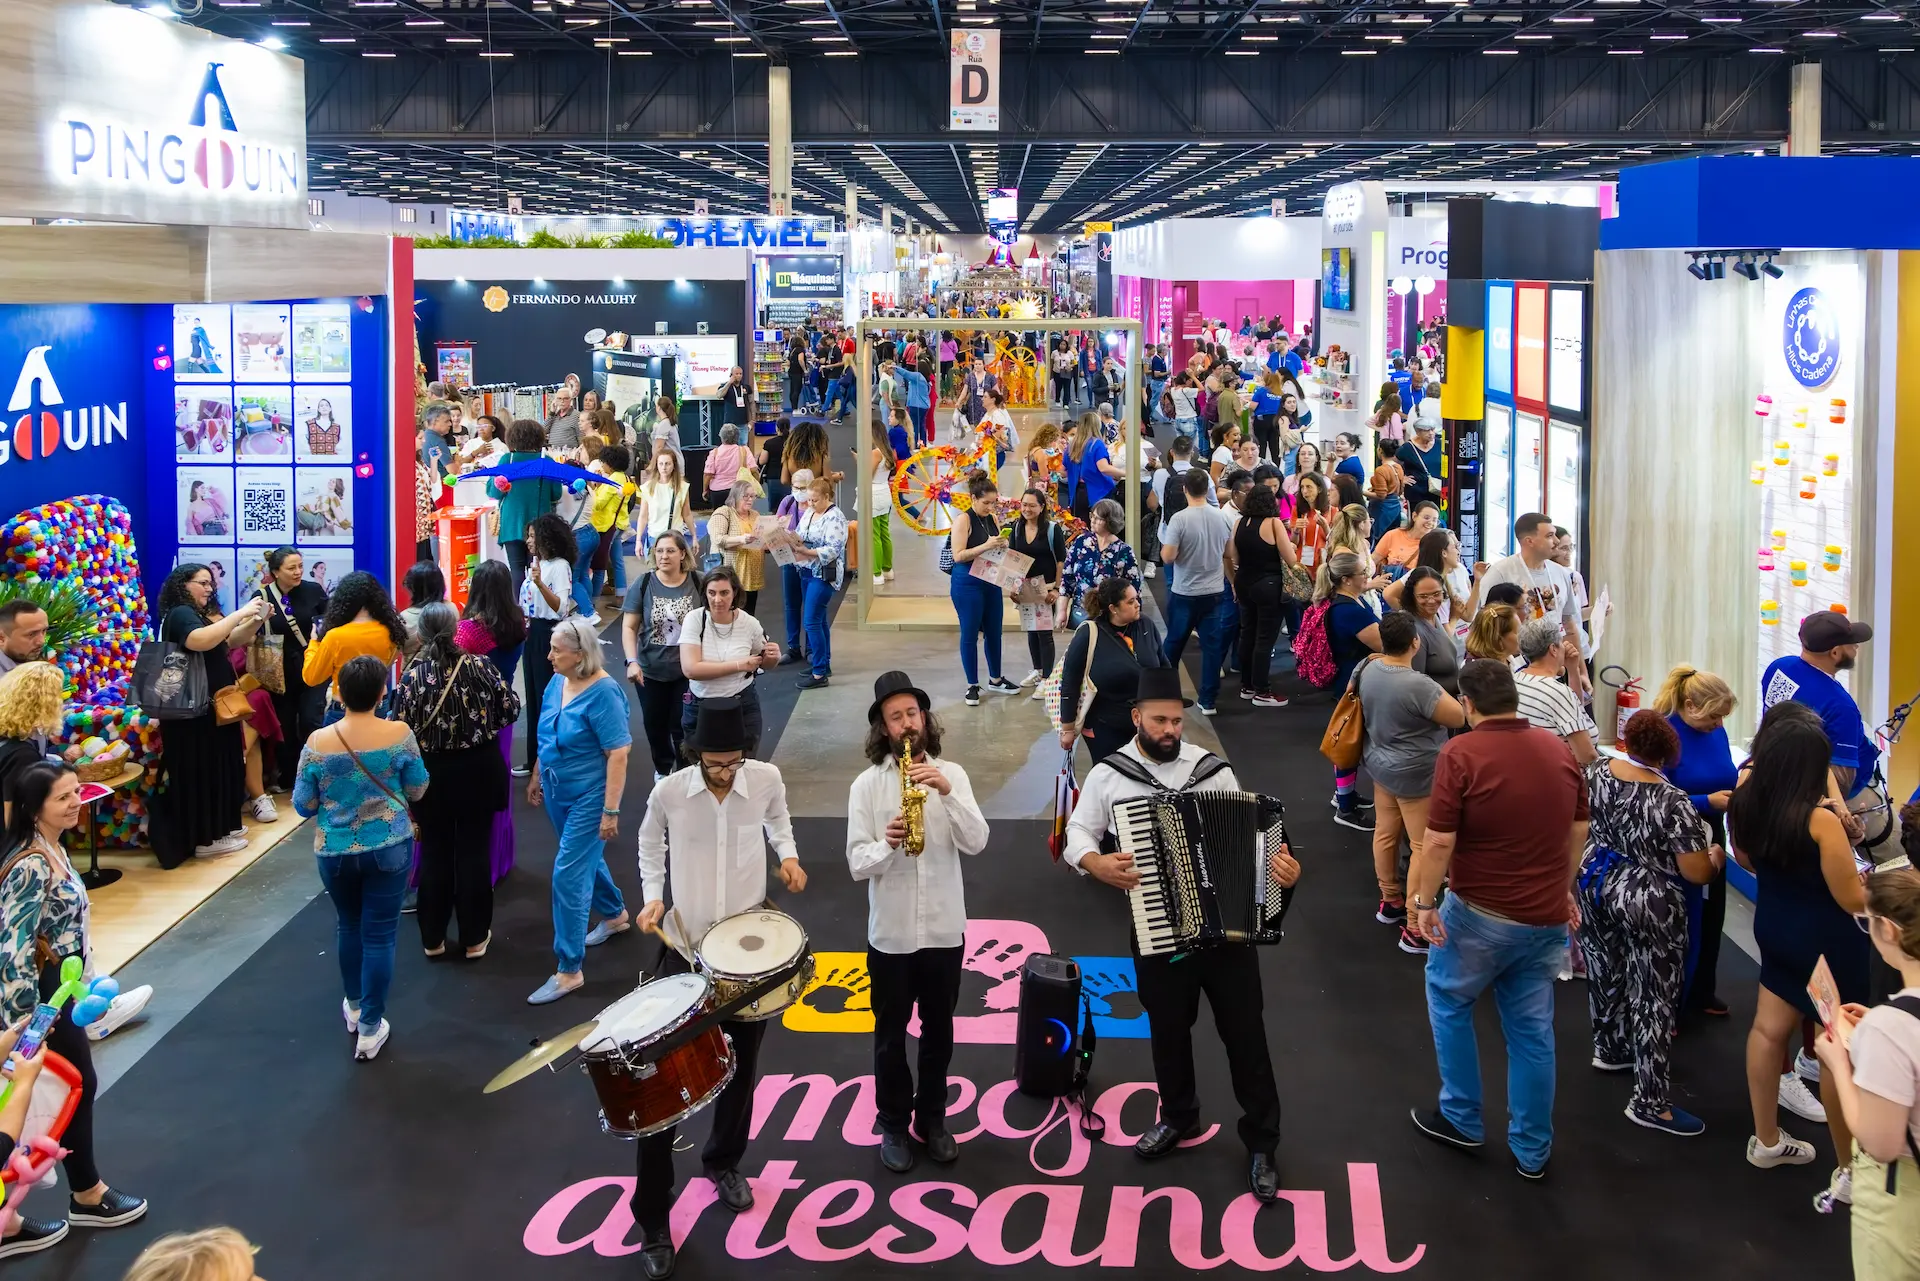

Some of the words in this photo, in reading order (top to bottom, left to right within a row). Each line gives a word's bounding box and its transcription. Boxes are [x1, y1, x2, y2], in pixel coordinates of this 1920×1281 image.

[968, 55, 983, 63] Rua
[961, 65, 989, 104] D
[68, 120, 298, 194] PINGOUIN
[656, 218, 827, 247] DREMEL
[1402, 247, 1448, 269] Prog
[512, 295, 580, 304] FERNANDO
[585, 295, 637, 304] MALUHY
[1787, 297, 1808, 329] Linhas
[1786, 344, 1801, 373] Hilos
[1802, 355, 1833, 380] Cadena
[523, 1160, 1427, 1274] artesanal
